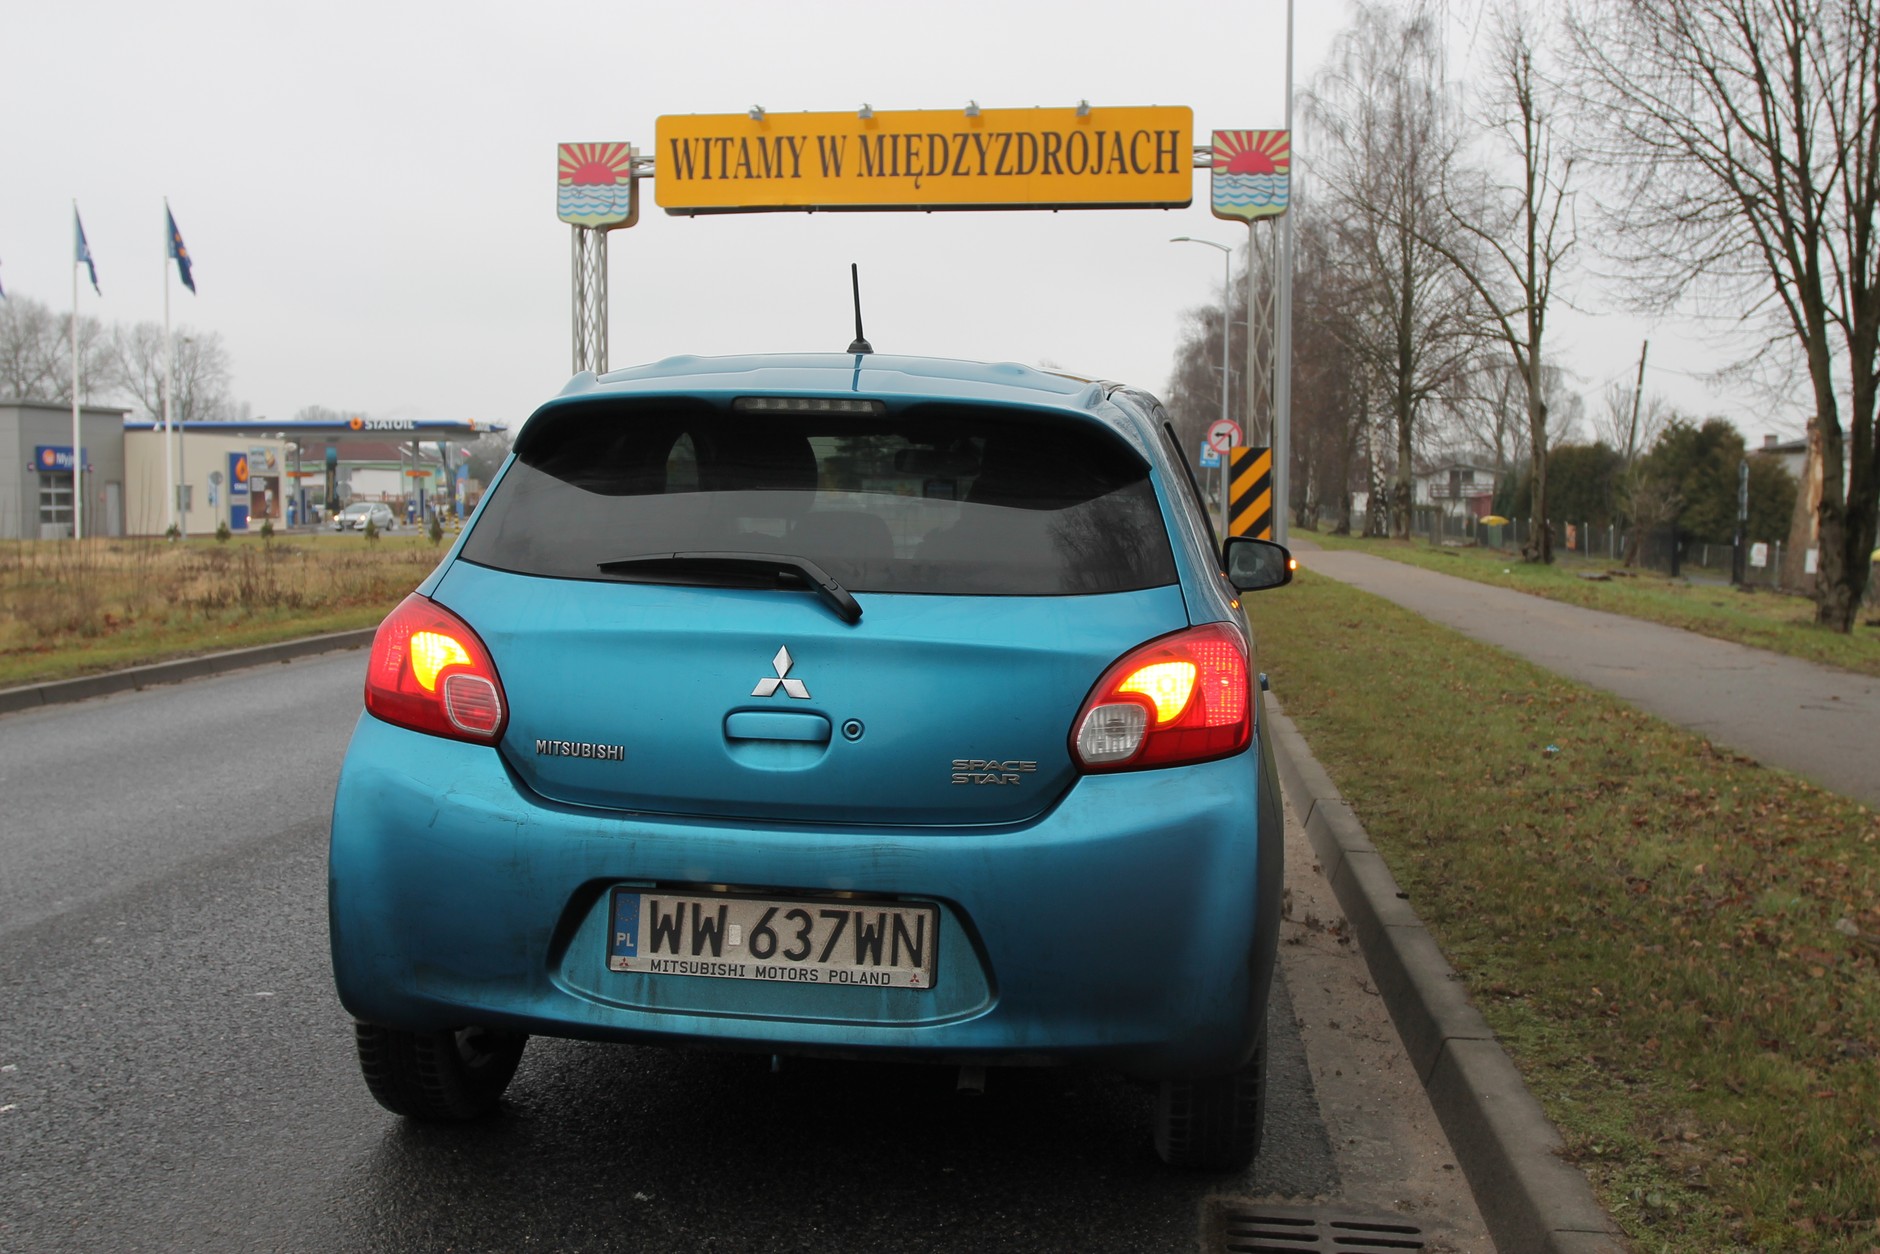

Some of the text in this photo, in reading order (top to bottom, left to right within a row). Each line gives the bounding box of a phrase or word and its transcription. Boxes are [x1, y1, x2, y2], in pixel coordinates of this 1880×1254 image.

[670, 129, 1180, 190] WITAMY W MIĘDZYZDROJACH
[364, 419, 415, 430] STATOIL
[536, 739, 624, 761] MITSUBISHI
[951, 759, 1037, 772] SPACE
[951, 773, 1020, 785] STAR
[616, 932, 634, 948] PL
[650, 900, 925, 969] WW 637WN
[650, 959, 891, 986] MITSUBISHI MOTORS POLAND
